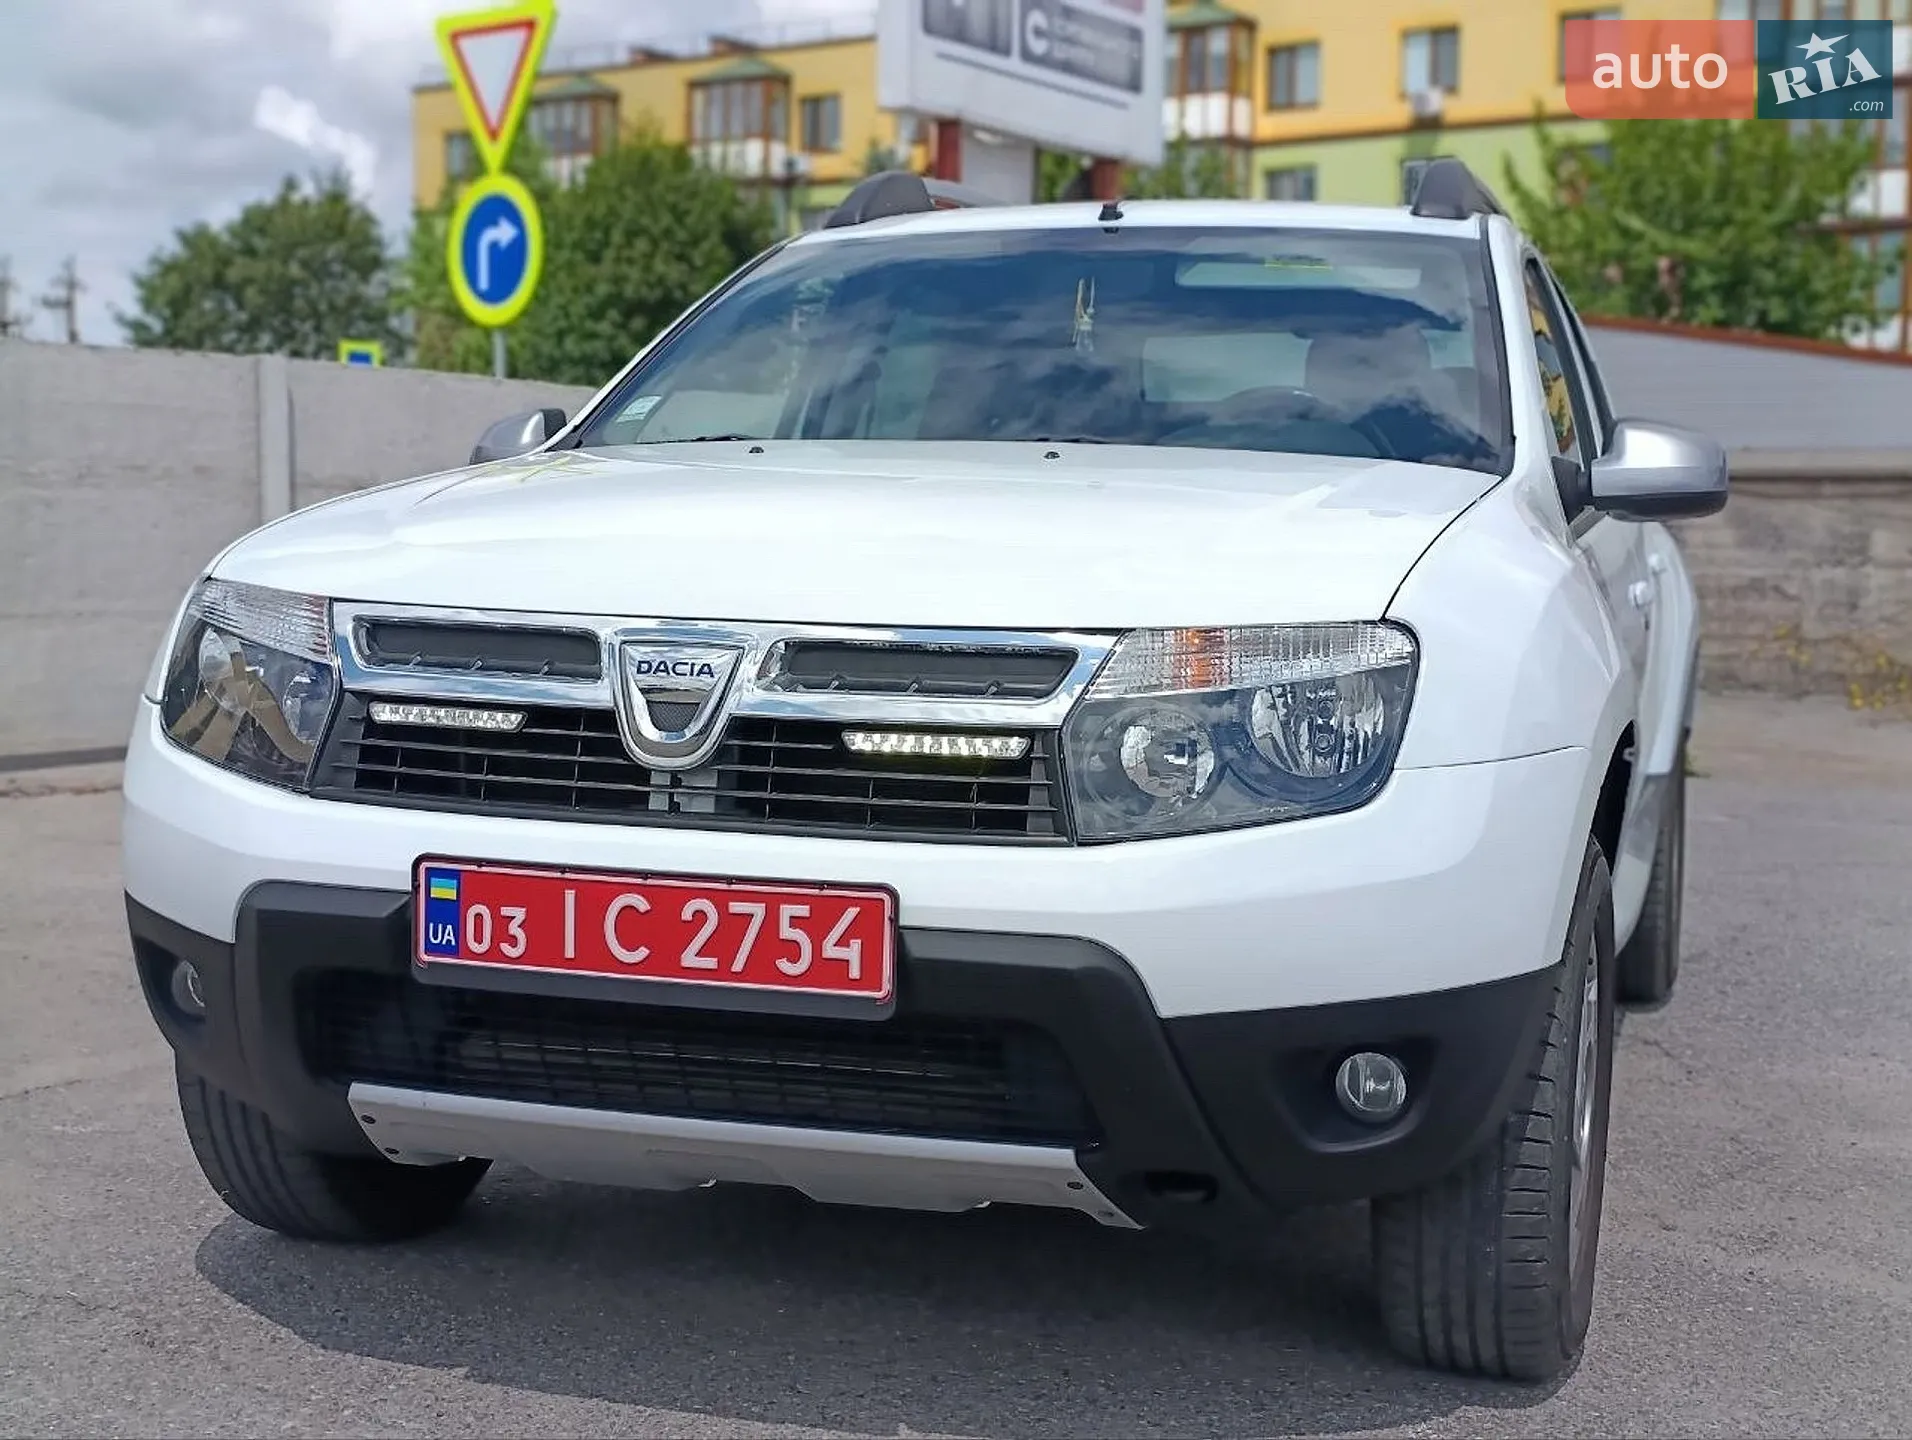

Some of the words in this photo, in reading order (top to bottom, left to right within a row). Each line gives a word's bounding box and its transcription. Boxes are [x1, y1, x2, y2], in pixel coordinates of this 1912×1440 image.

[636, 660, 715, 678] DACIA
[428, 922, 456, 946] UA
[464, 903, 528, 959] 03
[680, 898, 862, 980] 2754
